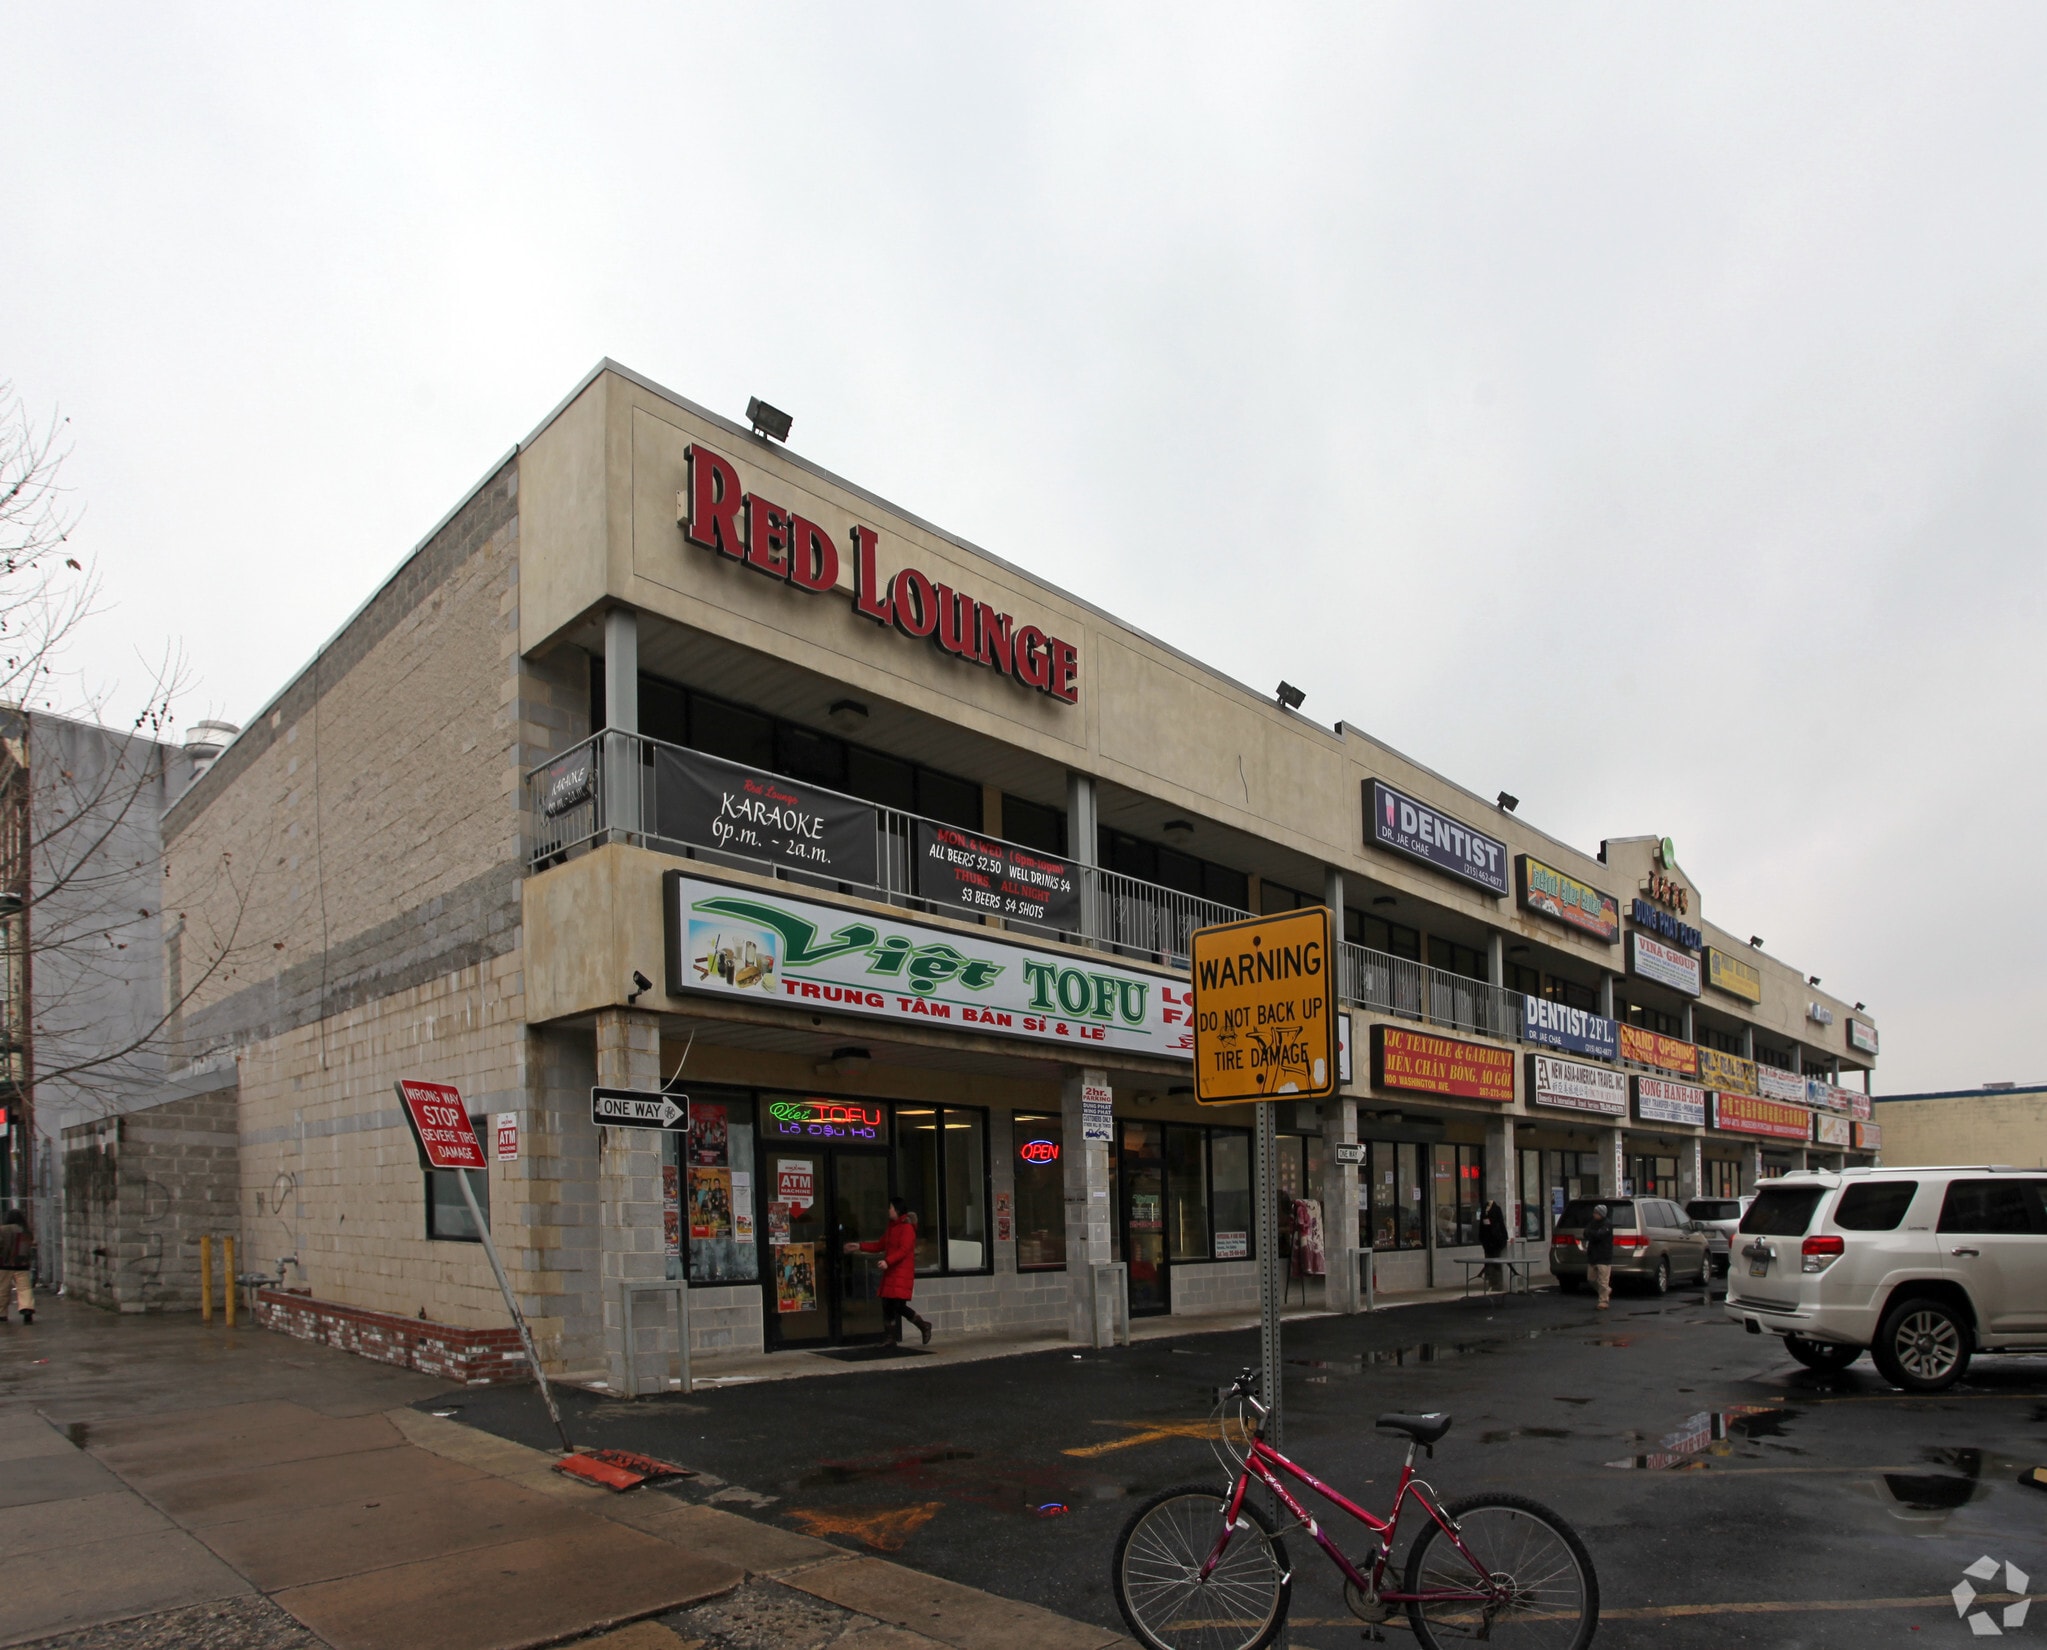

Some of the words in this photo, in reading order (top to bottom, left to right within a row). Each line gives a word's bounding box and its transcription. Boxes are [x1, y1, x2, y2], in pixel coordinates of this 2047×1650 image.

[684, 442, 839, 595] RED
[849, 524, 1079, 705] LOUNGE
[721, 792, 824, 839] KARAOKE
[712, 815, 762, 847] 6p.m.
[786, 839, 831, 864] 2a.m.
[937, 828, 968, 849] MON.
[969, 838, 977, 851] &
[979, 839, 1004, 860] WED.
[1381, 825, 1395, 841] DR.
[1396, 832, 1409, 847] JAE
[1411, 839, 1430, 857] CHAE
[1400, 801, 1498, 872] DENTIST
[929, 843, 945, 860] ALL
[947, 848, 974, 868] BEERS
[976, 855, 1002, 874] $2.50
[1009, 864, 1029, 882] WELL
[1030, 870, 1059, 890] DRINKS
[1060, 878, 1071, 893] $4
[1463, 862, 1478, 878] (215)
[953, 867, 991, 889] THURS.
[1001, 880, 1020, 896] ALL
[1021, 884, 1051, 903] NIGHT
[961, 887, 973, 903] $3
[974, 890, 1000, 909] BEERS
[1004, 897, 1017, 913] $4
[1018, 901, 1044, 919] SHOTS
[1199, 941, 1321, 992] WARNING
[1638, 936, 1664, 959] VINA
[1666, 949, 1697, 971] GROUP
[1022, 957, 1149, 1025] TOFU
[781, 979, 885, 1008] TRUNG
[896, 996, 951, 1019] TÂM
[962, 1006, 1013, 1027] BÁN
[1055, 1023, 1070, 1036] &
[1200, 1011, 1218, 1032] DO
[1224, 1006, 1251, 1031] NOT
[1257, 1000, 1296, 1025] BACK
[1302, 997, 1323, 1019] UP
[1527, 995, 1588, 1038] DENTIST
[1589, 1016, 1614, 1043] 2FL.
[1406, 1033, 1453, 1058] TEXTILE
[1454, 1043, 1464, 1060] &
[1465, 1043, 1514, 1068] GARMENT
[1528, 1029, 1538, 1040] DR.
[1539, 1032, 1548, 1042] JAE
[1548, 1034, 1562, 1045] CHAE
[1620, 1024, 1655, 1051] GRAND
[1658, 1037, 1696, 1060] OPENING
[1214, 1049, 1244, 1072] TIRE
[1251, 1042, 1310, 1067] DAMAGE
[1399, 1075, 1437, 1089] WASHINGTON
[1438, 1081, 1450, 1092] AVE.
[1551, 1061, 1563, 1080] NEW
[1564, 1064, 1596, 1086] ASIA-AMERICA
[405, 1087, 440, 1103] WRONG
[441, 1091, 460, 1106] WAY
[1085, 1087, 1107, 1097] 2hr.
[1639, 1079, 1662, 1098] SONG
[1664, 1083, 1704, 1105] HANH-ABC
[423, 1105, 459, 1128] STOP
[604, 1099, 631, 1116] ONE
[635, 1102, 662, 1118] WAY
[812, 1104, 881, 1125] TOFU
[422, 1128, 458, 1143] SEVERE
[458, 1131, 477, 1145] TIRE
[499, 1129, 516, 1145] ATM
[1021, 1143, 1059, 1160] OPEN
[437, 1145, 476, 1160] DAMAGE
[1339, 1149, 1349, 1158] ONE
[1349, 1150, 1358, 1158] WAY
[781, 1175, 811, 1188] ATM
